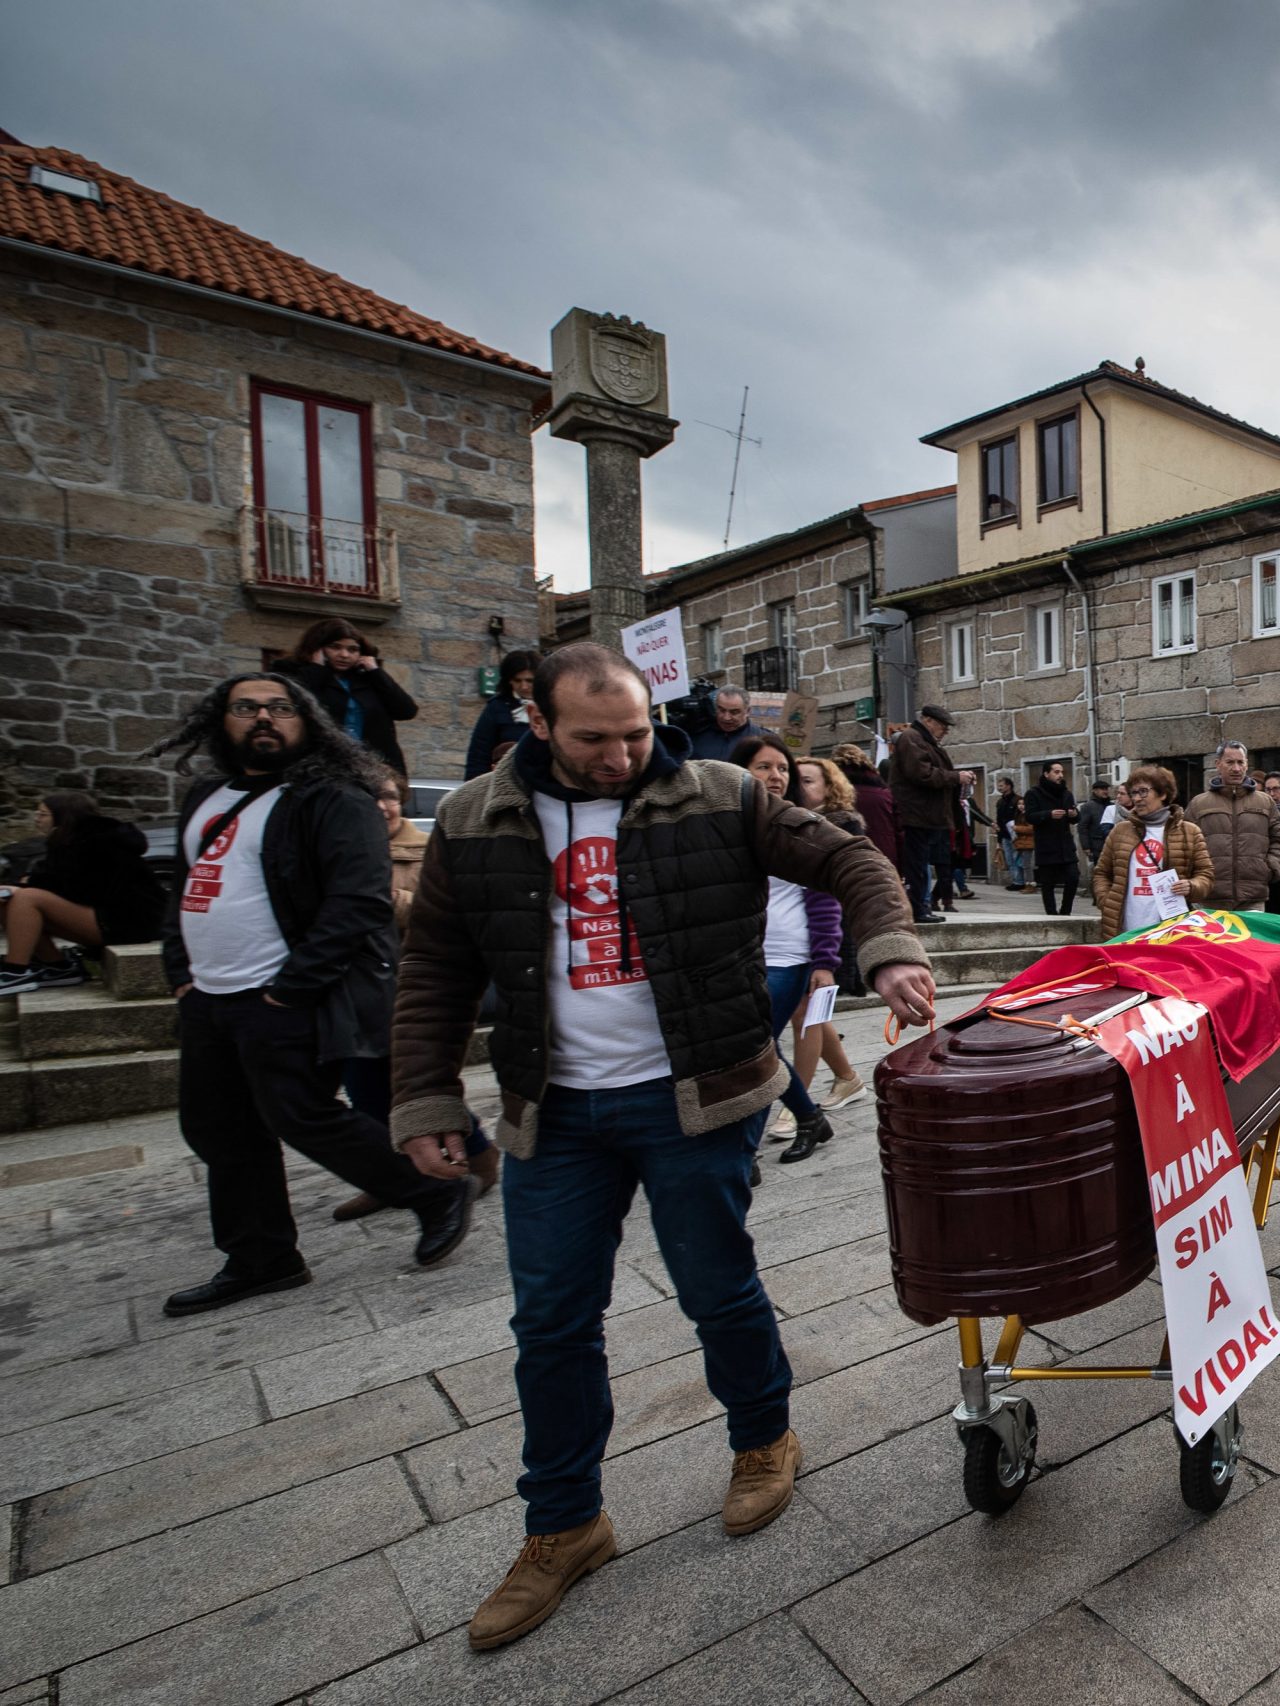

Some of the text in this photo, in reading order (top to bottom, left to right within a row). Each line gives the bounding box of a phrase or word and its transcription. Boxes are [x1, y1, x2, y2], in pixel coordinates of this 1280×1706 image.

[603, 942, 618, 957] à
[1174, 1072, 1196, 1123] À
[1150, 1128, 1233, 1214] MINA
[1174, 1195, 1233, 1270] SIM
[1206, 1271, 1232, 1323] À
[1178, 1305, 1279, 1417] VIDA!
